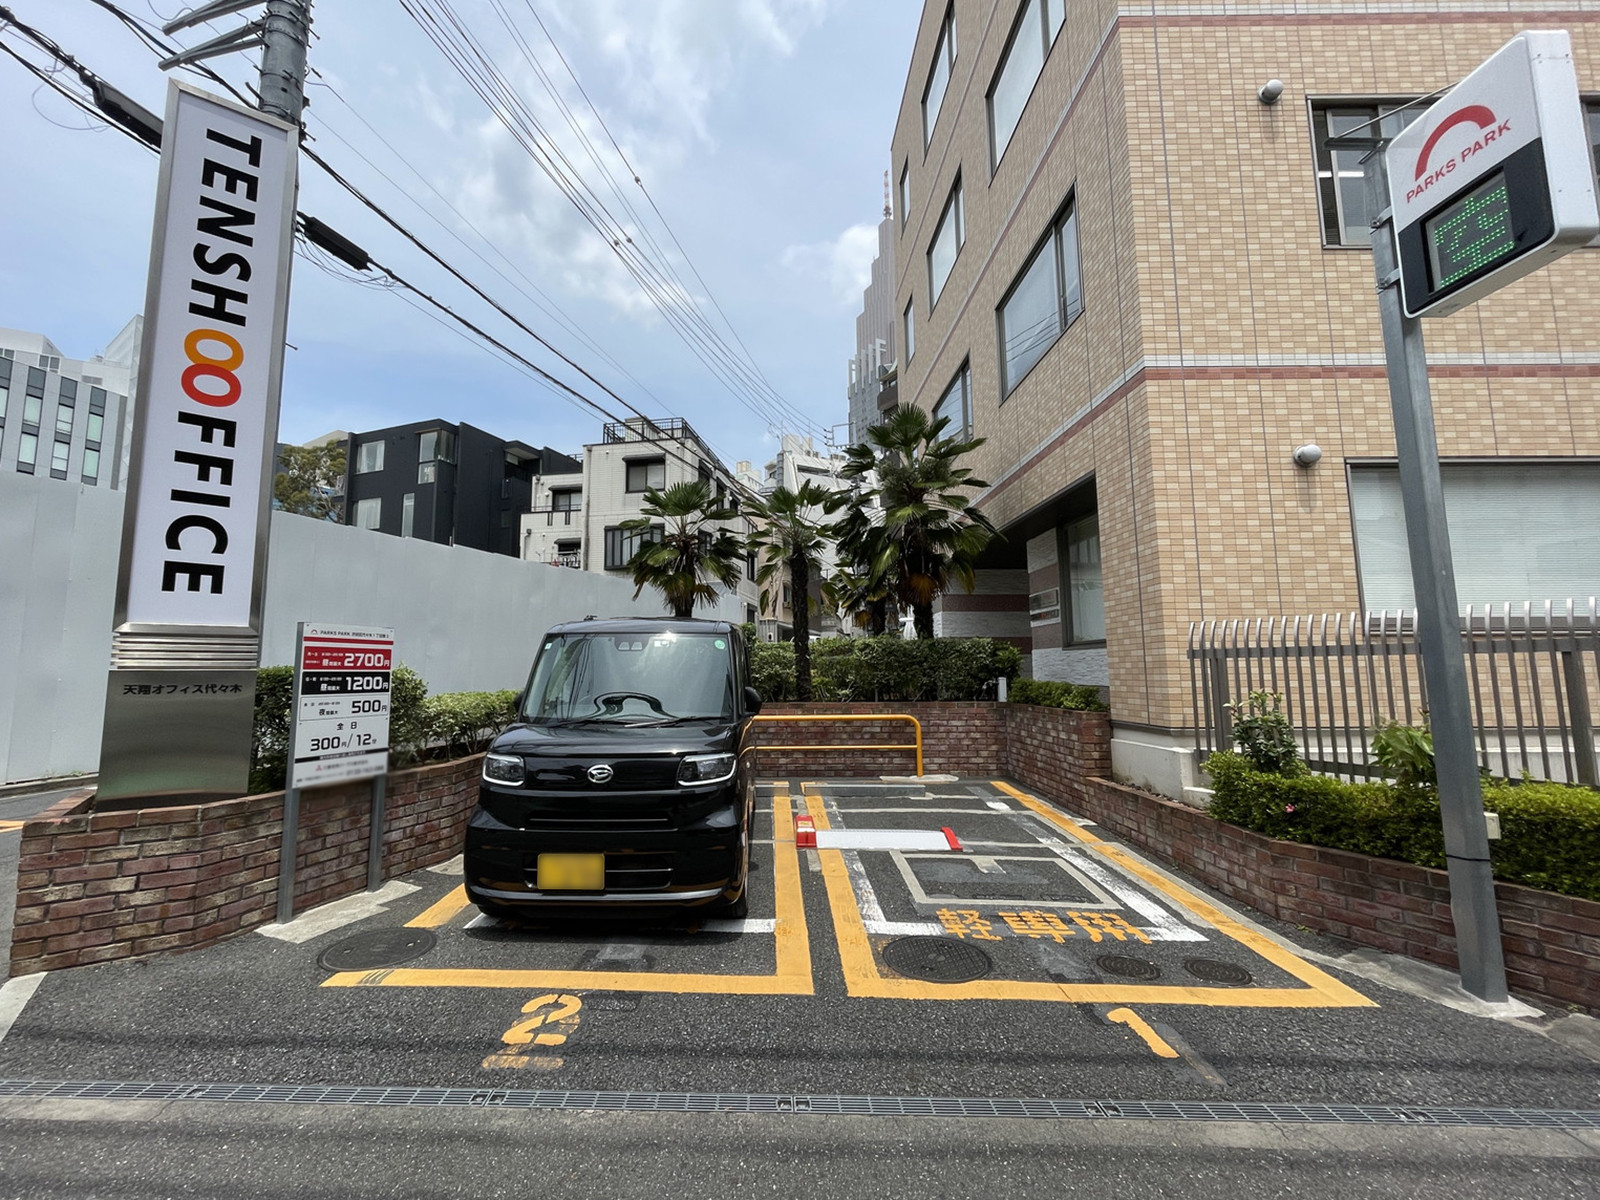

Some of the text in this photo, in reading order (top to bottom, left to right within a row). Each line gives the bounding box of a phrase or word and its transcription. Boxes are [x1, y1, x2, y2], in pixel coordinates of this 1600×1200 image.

[1406, 118, 1512, 204] PARKS PARK
[1433, 185, 1516, 288] 空
[343, 652, 390, 667] 2700円
[122, 683, 243, 696] 天翔オフィス代々木
[345, 676, 389, 691] 1200円
[351, 699, 387, 714] 500円
[934, 906, 1154, 945] 軽専用
[500, 993, 583, 1047] 2
[1105, 1006, 1181, 1059] 1
